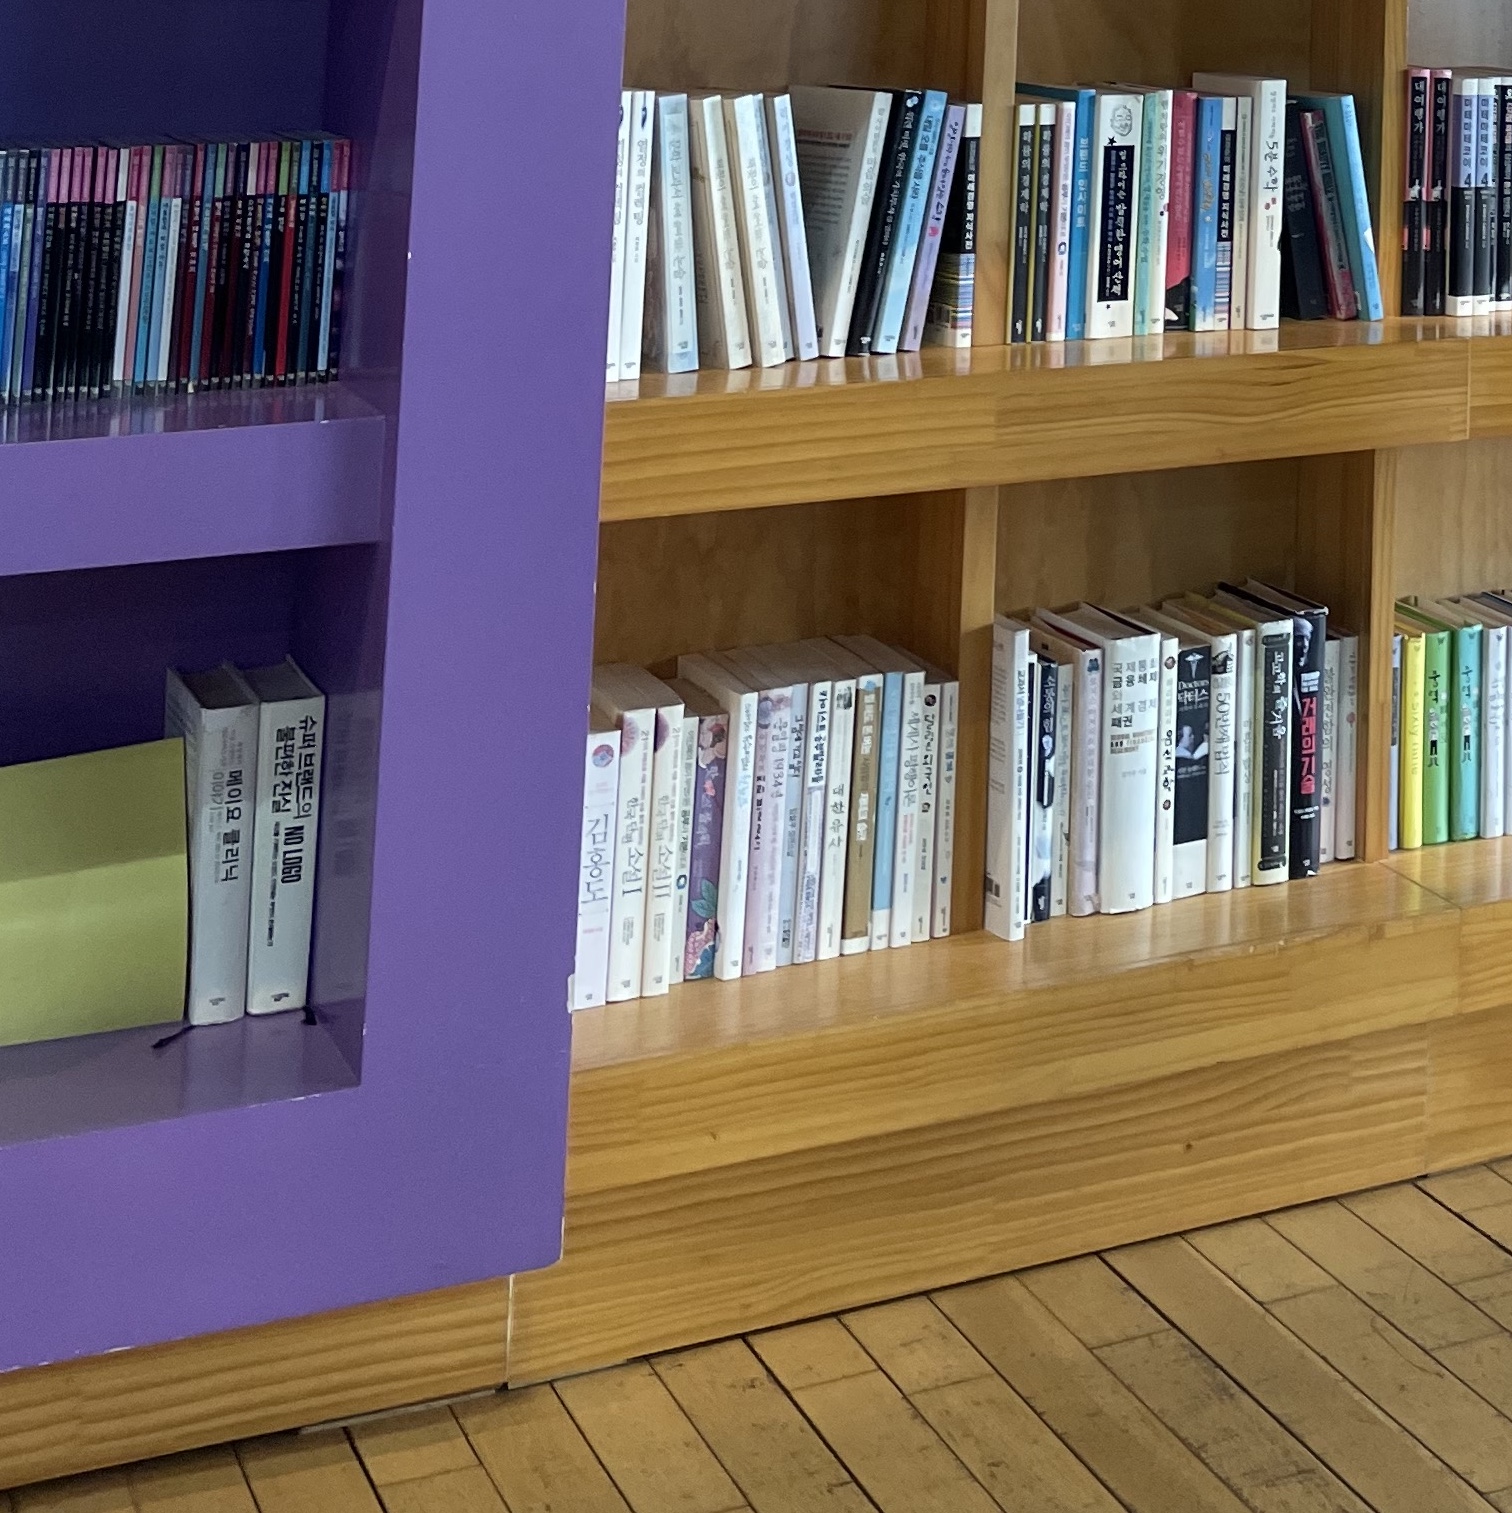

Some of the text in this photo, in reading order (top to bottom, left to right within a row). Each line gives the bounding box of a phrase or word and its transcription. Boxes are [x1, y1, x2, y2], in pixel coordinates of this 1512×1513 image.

[919, 134, 930, 151] 오를
[915, 154, 926, 179] 주식을
[1264, 140, 1278, 191] 5분 수학
[1464, 173, 1471, 188] 4
[1480, 173, 1488, 188] 4
[910, 182, 921, 199] 사라
[1271, 650, 1286, 693] 고고학의
[817, 690, 827, 733] 카이스트
[906, 710, 921, 750] 세계사
[1111, 715, 1132, 728] 패권
[1300, 696, 1317, 794] 거래의 기술
[272, 726, 295, 814] 불편한 진실
[293, 715, 317, 819] 슈퍼 브랜드의
[209, 772, 223, 810] 이야기
[221, 769, 243, 882] 메이요 클리닉
[622, 797, 644, 883] 한국 단편 소설
[653, 795, 673, 881] 한국 단편 소설
[280, 825, 305, 883] NO LOGO
[581, 813, 610, 904] 김홍도
